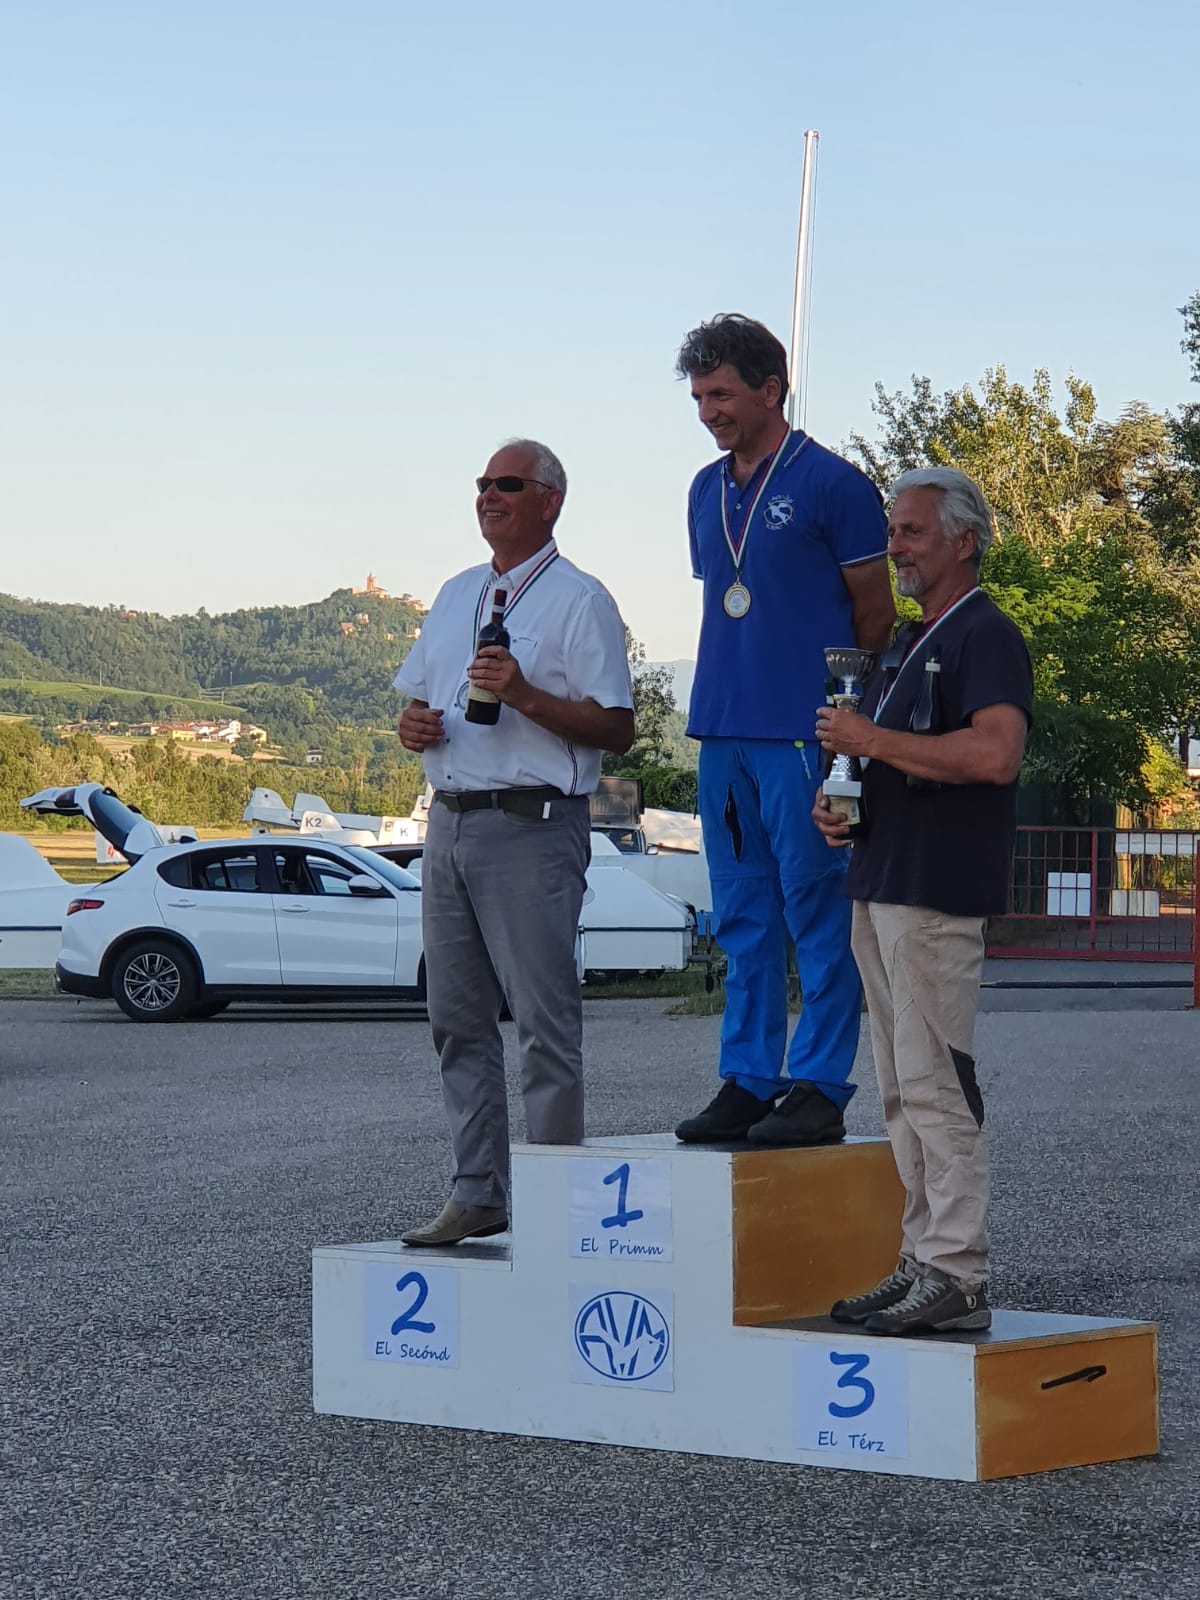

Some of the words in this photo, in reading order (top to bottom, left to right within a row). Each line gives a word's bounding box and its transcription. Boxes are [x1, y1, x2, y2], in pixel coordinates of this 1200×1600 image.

[305, 817, 322, 828] K2
[400, 828, 409, 837] K
[601, 1163, 643, 1227] 1
[580, 1237, 599, 1252] El
[609, 1239, 664, 1255] Primm
[391, 1271, 436, 1336] 2
[375, 1340, 392, 1356] El
[400, 1343, 451, 1361] Secónd
[828, 1351, 875, 1418] 3
[818, 1431, 838, 1446] El
[848, 1433, 885, 1452] Térz
